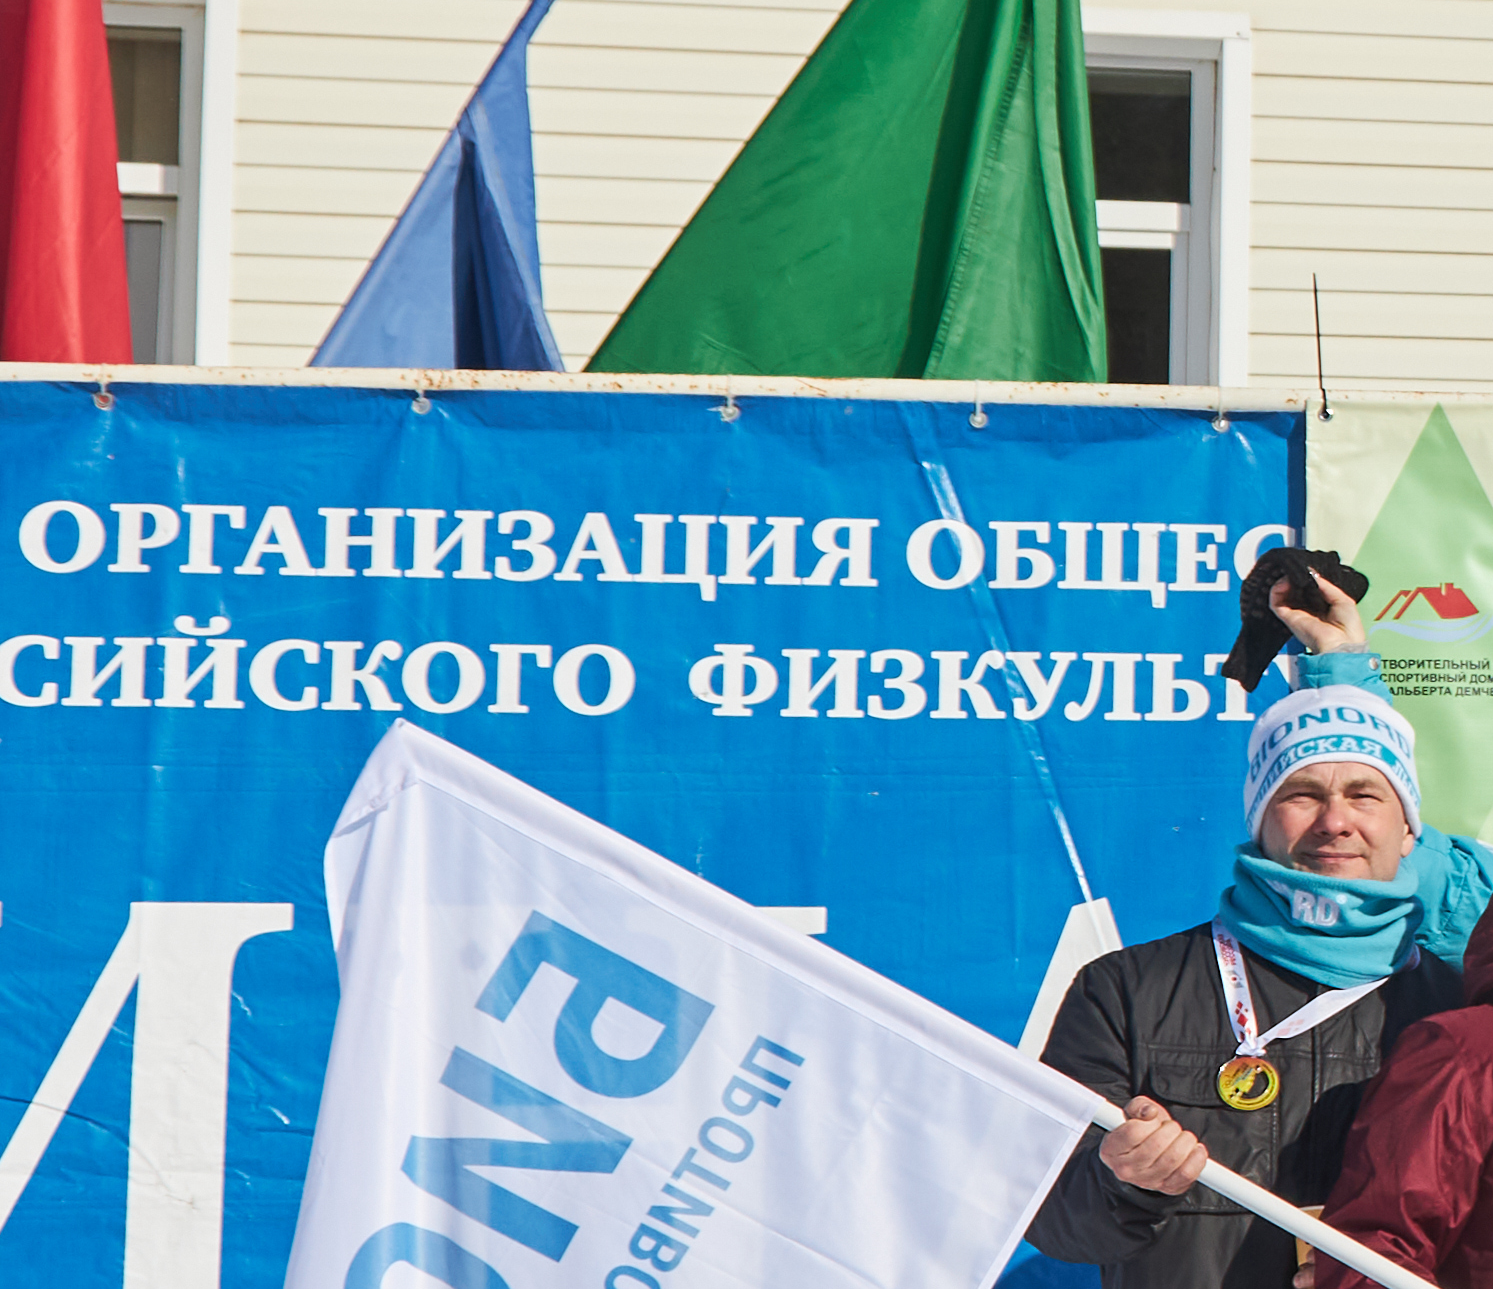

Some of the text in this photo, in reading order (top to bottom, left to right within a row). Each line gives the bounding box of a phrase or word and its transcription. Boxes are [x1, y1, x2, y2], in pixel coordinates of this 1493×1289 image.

[17, 497, 880, 602] ОРГАНИЗАЦИЯ
[1379, 672, 1466, 684] СПОРТИВНЫЙ
[1389, 686, 1452, 696] АЛЬБЕРТА
